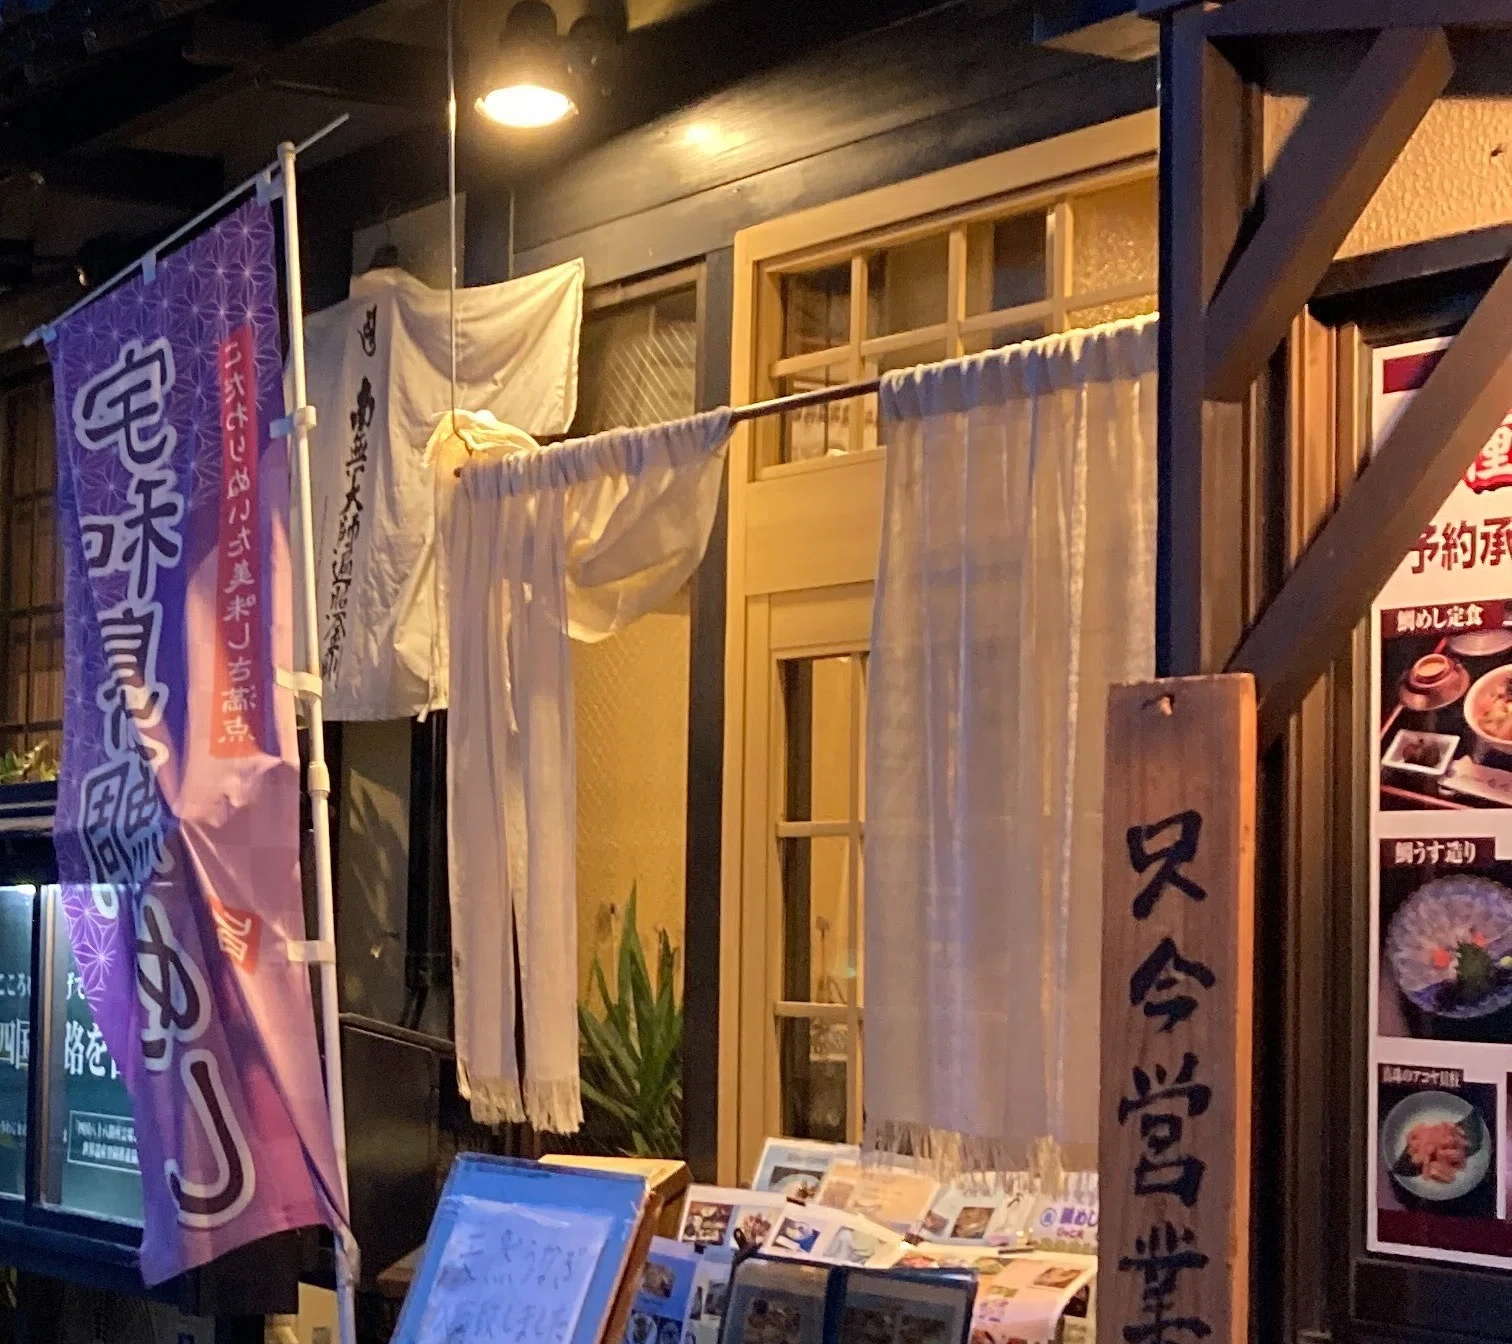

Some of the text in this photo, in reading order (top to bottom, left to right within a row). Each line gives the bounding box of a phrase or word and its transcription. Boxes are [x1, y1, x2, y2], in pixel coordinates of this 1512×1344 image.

[1396, 603, 1485, 633] 鯛めし定食
[1394, 840, 1477, 865] 鯛うす造り
